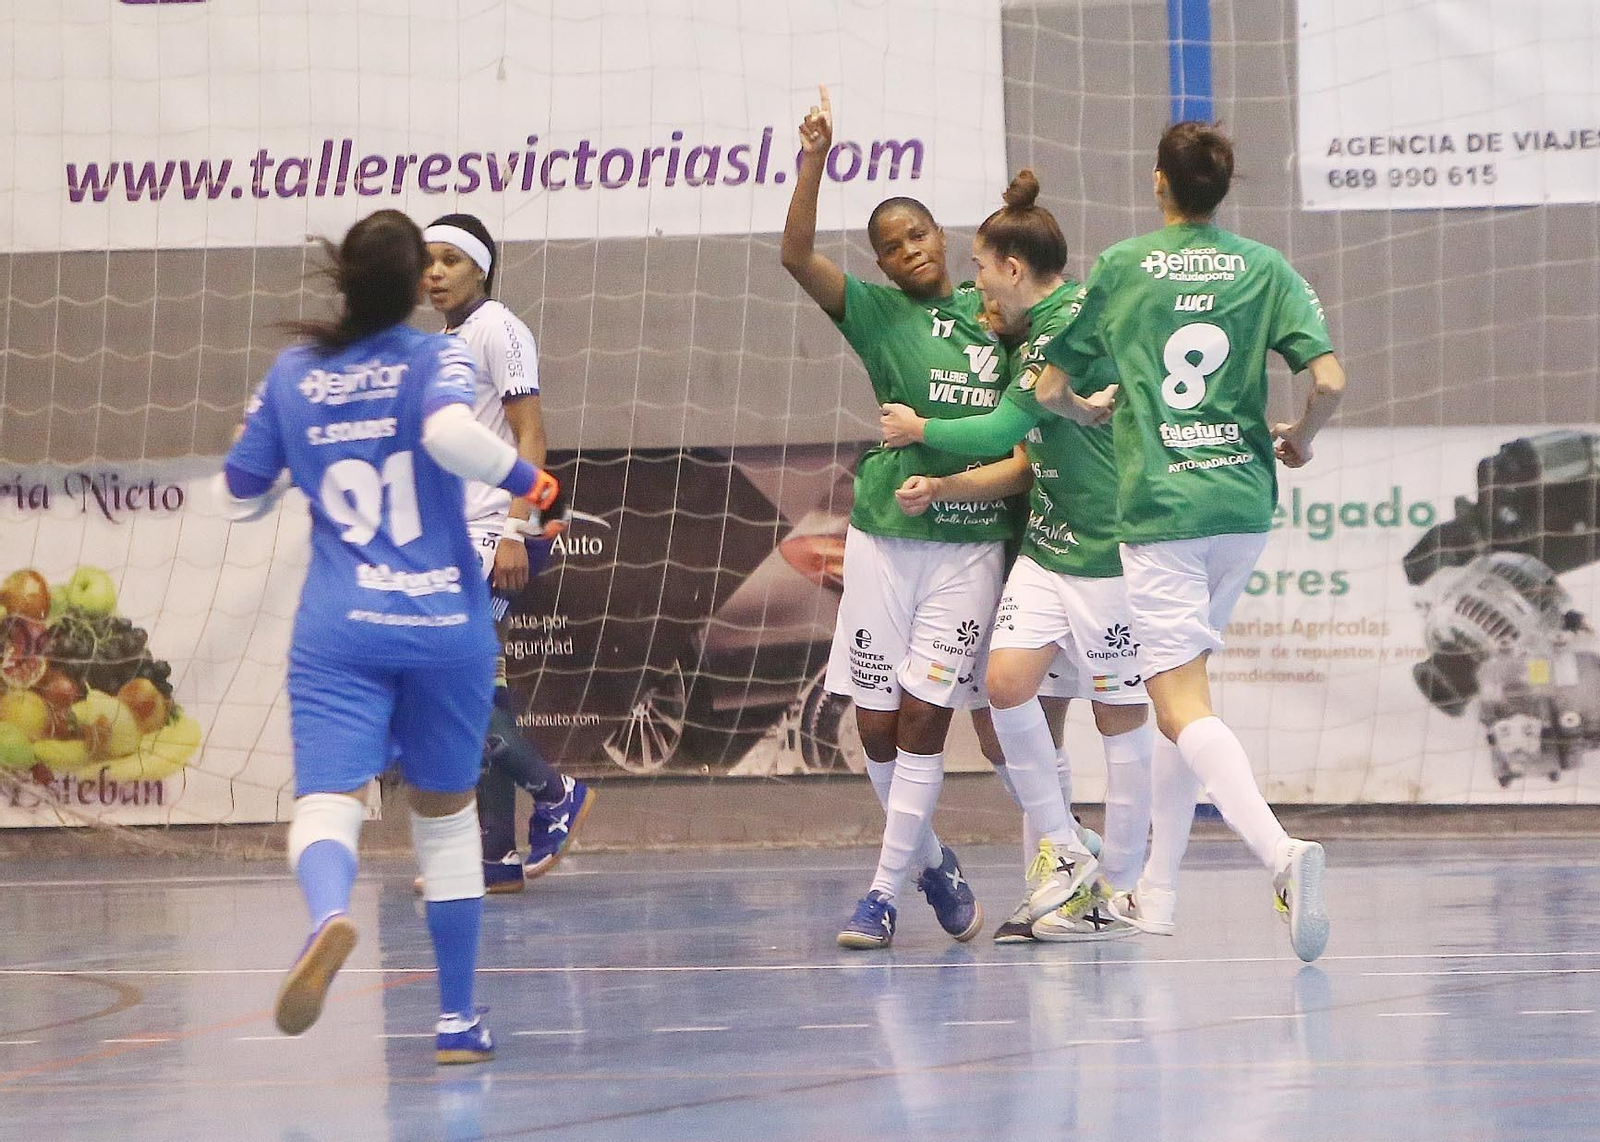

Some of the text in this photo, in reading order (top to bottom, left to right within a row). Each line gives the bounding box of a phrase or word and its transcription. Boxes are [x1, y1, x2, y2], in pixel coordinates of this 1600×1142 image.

[1326, 129, 1600, 157] AGENCIA DE VIAJE
[1327, 164, 1498, 189] 689 990 615
[1174, 294, 1215, 313] LUCI
[929, 368, 969, 385] TALLERES
[1161, 322, 1230, 410] 8
[320, 449, 423, 548] 91
[550, 532, 604, 556] Auto
[542, 614, 569, 634] por
[505, 636, 574, 660] eguridad
[932, 640, 963, 655] Grupo
[1086, 649, 1118, 660] Grupo
